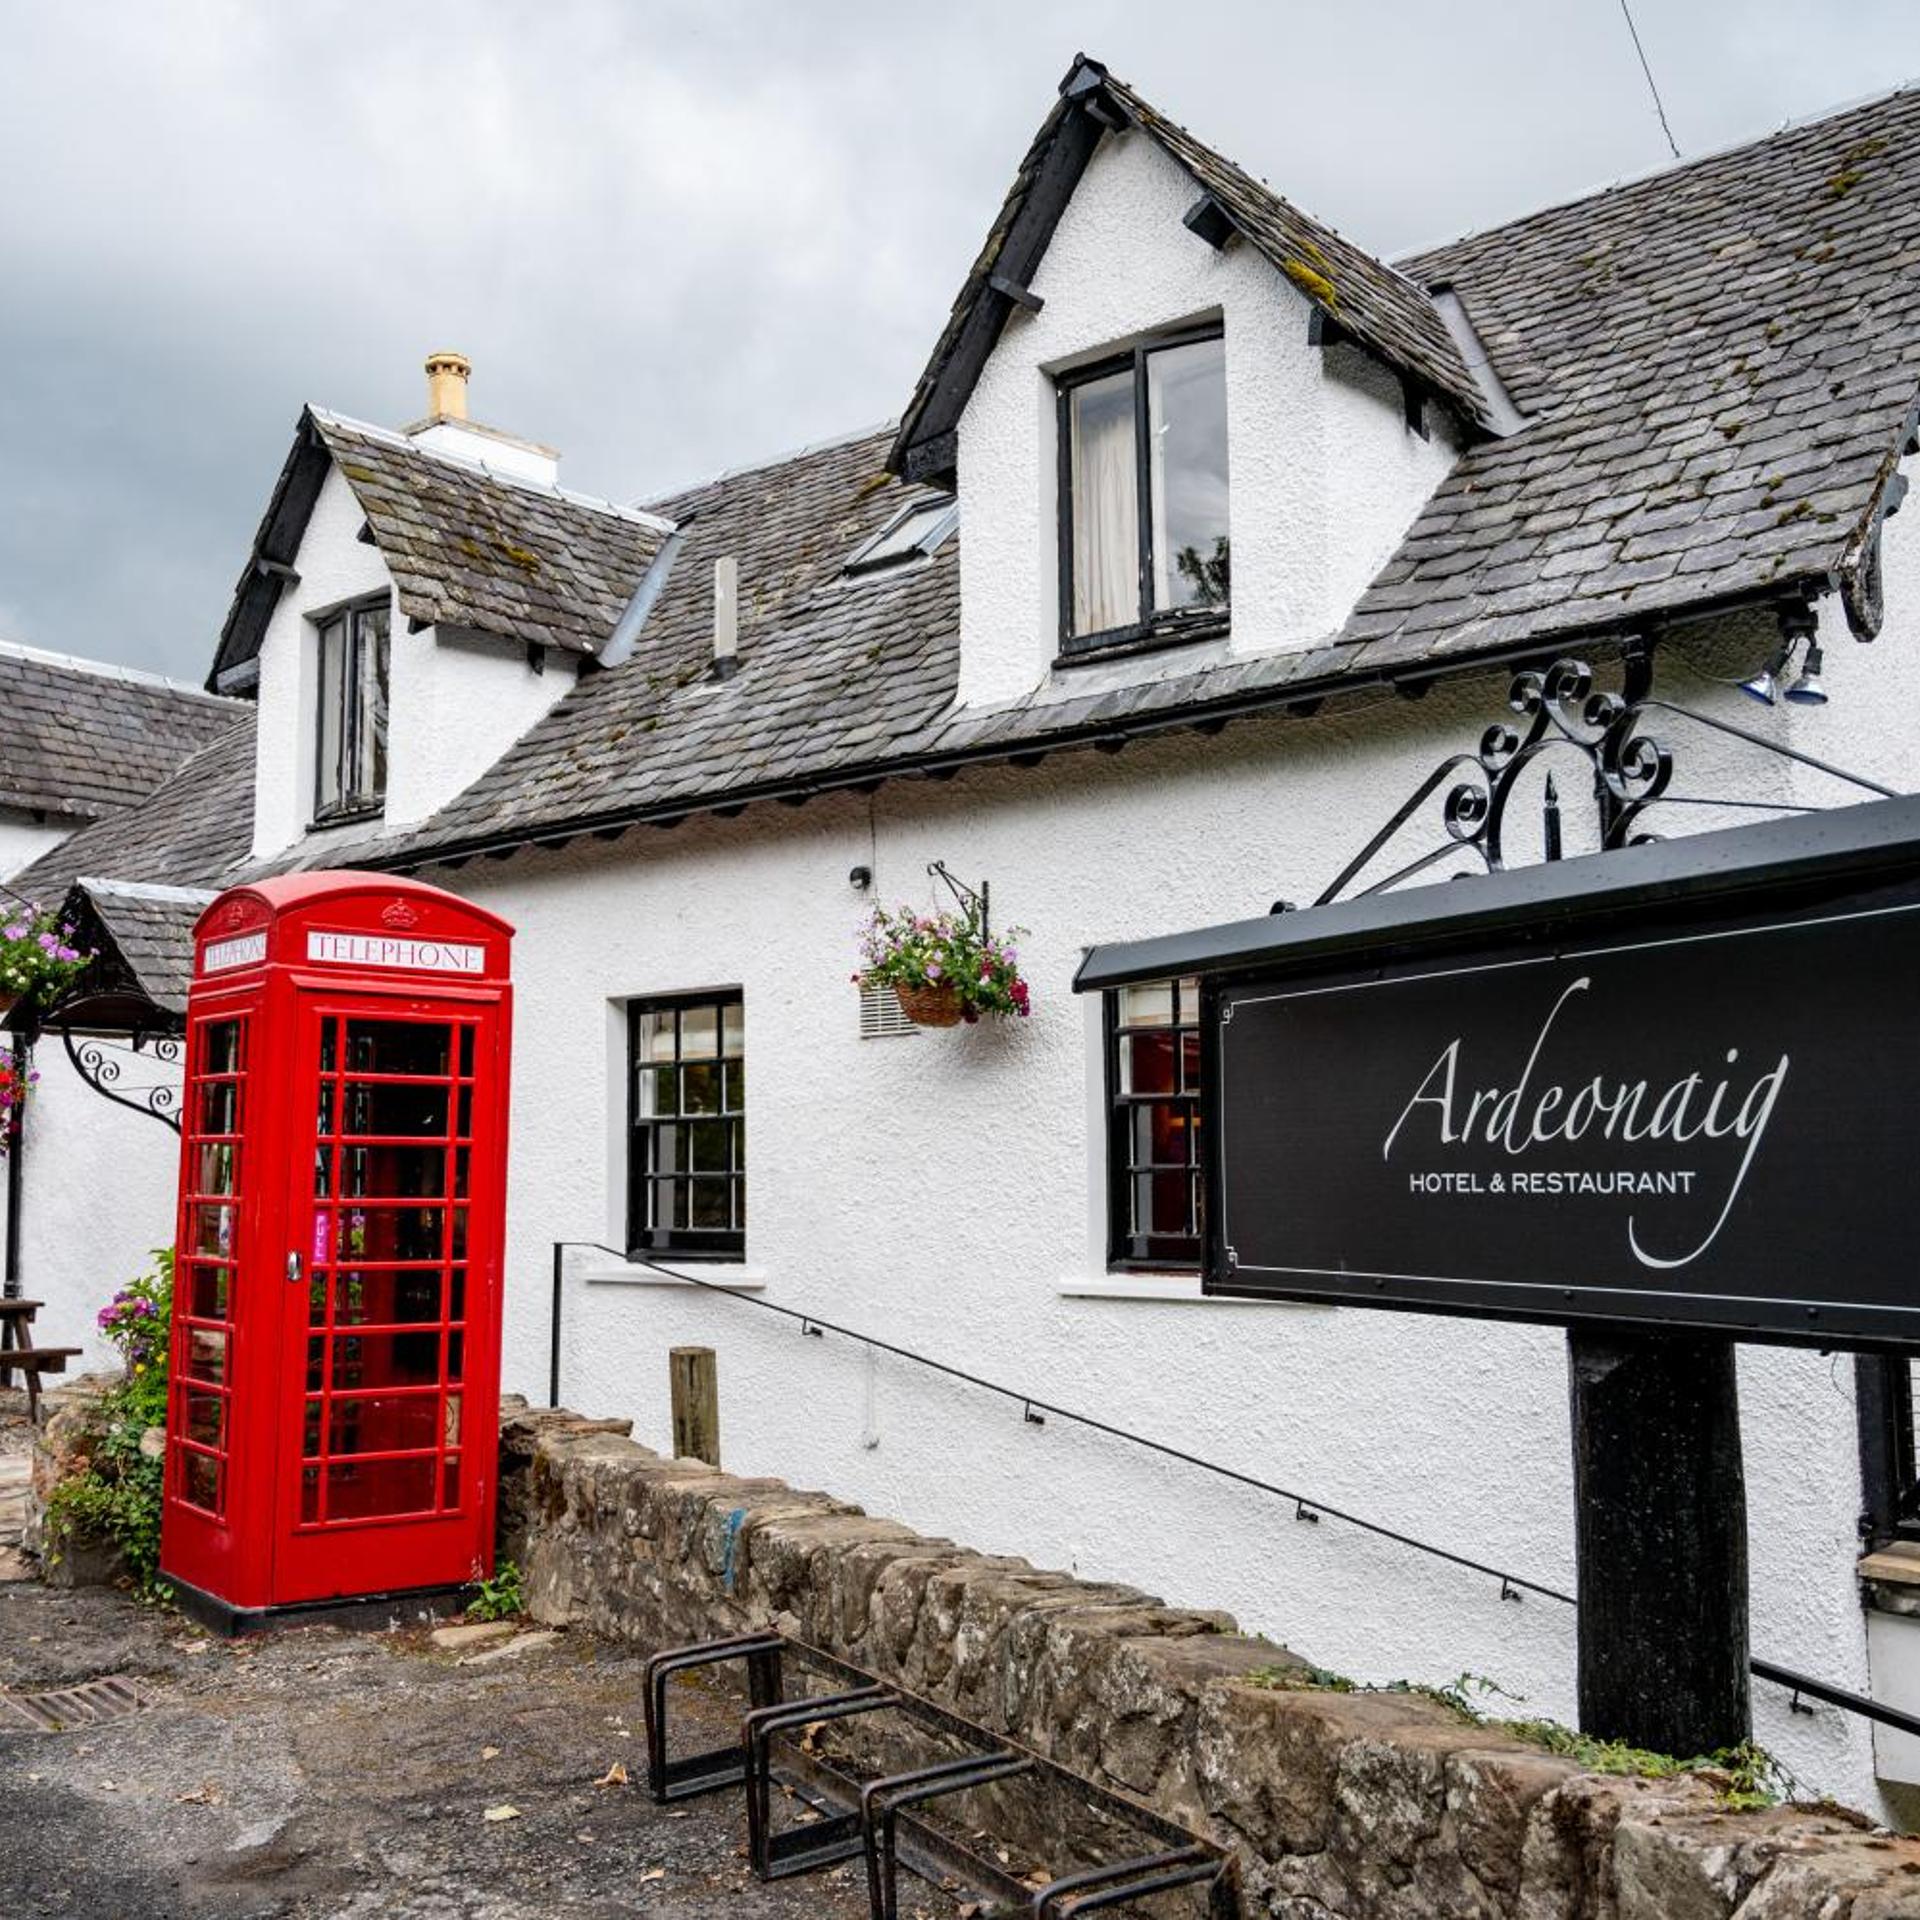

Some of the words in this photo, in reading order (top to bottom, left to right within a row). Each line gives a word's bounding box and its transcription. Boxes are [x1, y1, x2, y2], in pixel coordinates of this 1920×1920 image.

[313, 934, 478, 970] TELEPHONE
[1384, 977, 1789, 1268] Ardeonaig
[1409, 1172, 1485, 1194] HOTEL
[1489, 1172, 1506, 1194] &
[1511, 1171, 1696, 1194] RESTAURANT
